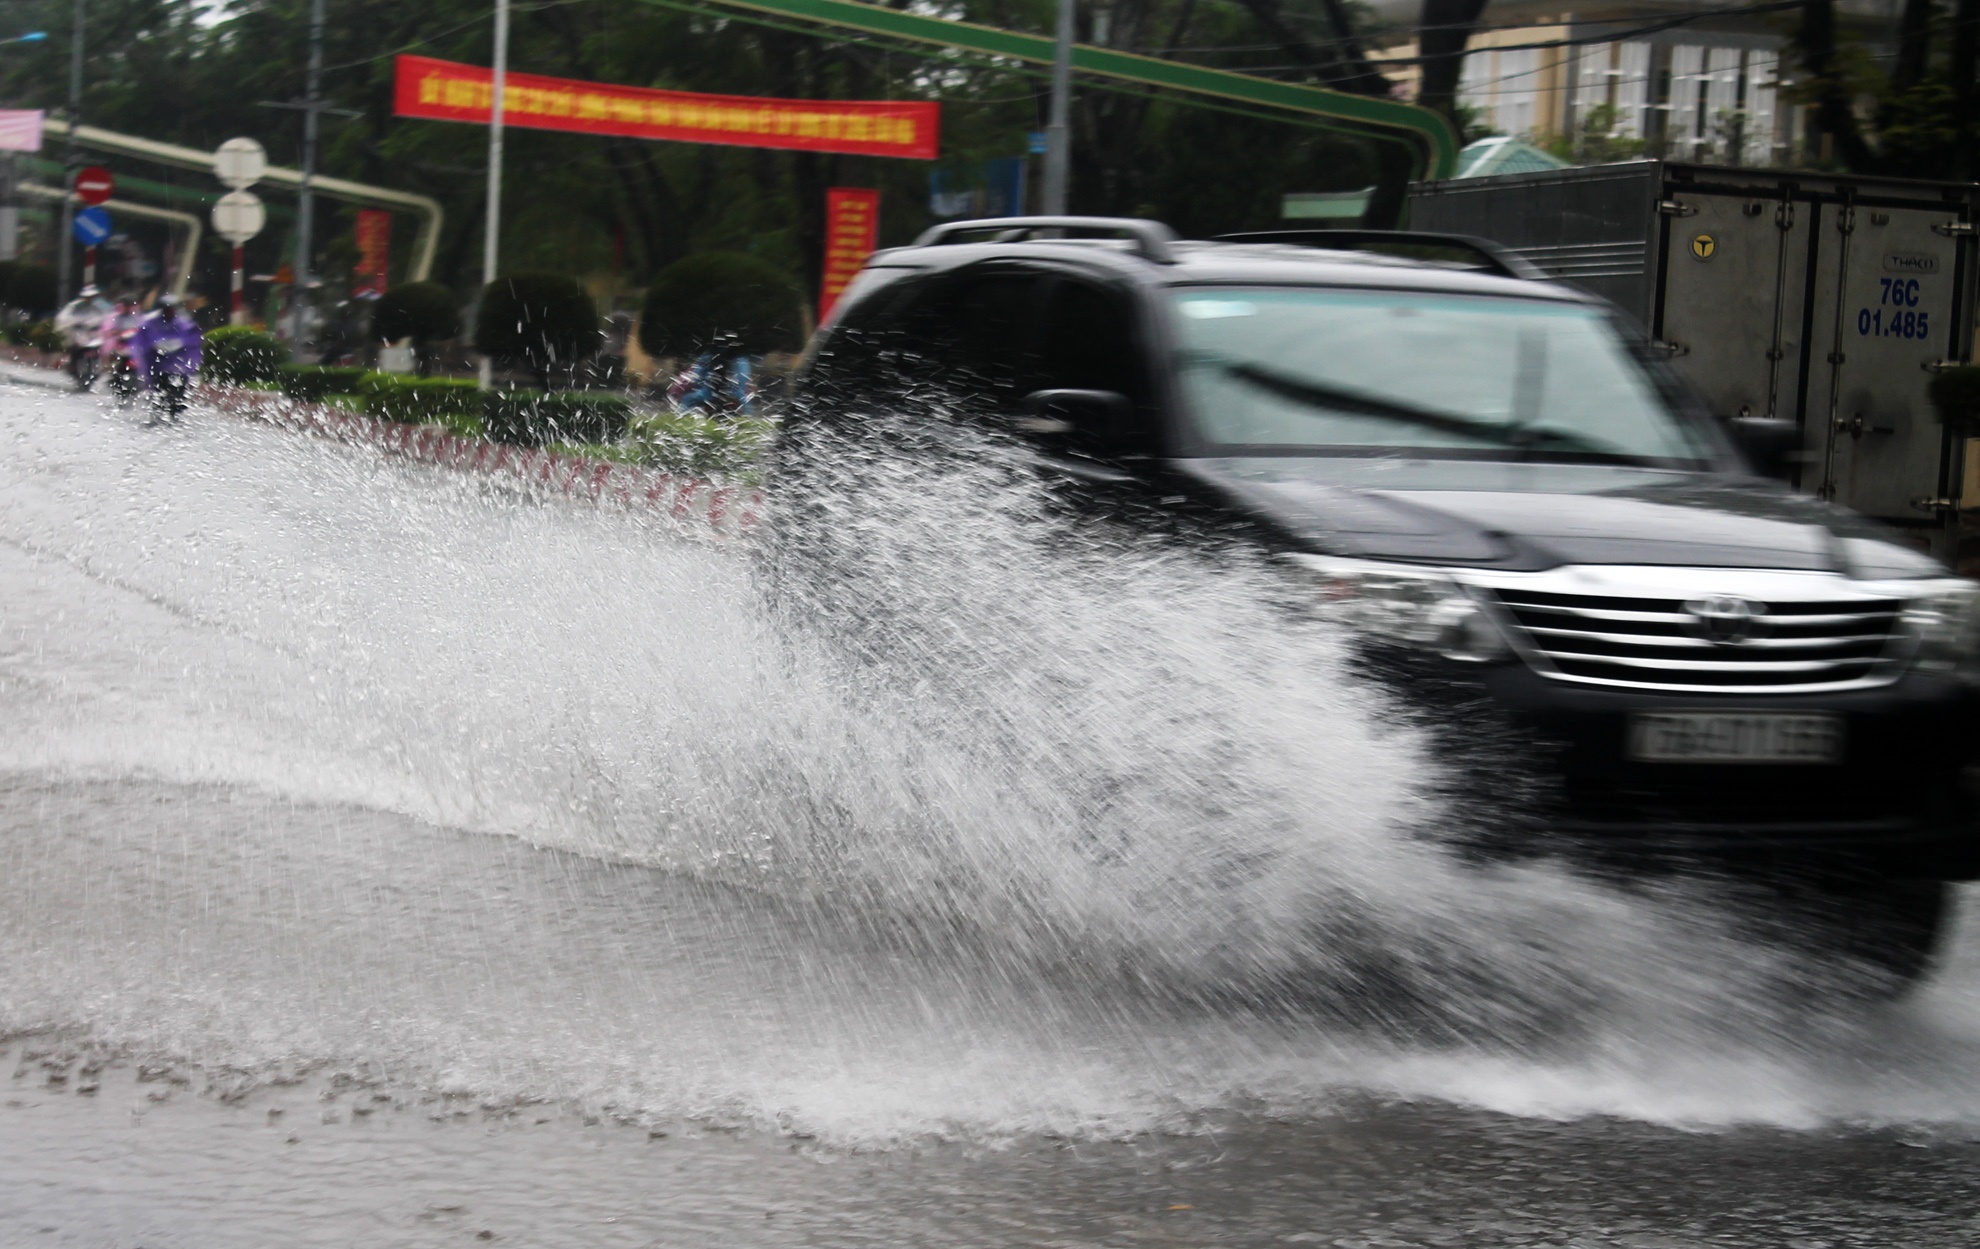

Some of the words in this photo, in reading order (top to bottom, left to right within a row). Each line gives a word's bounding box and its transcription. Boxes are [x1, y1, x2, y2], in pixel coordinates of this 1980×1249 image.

[1891, 256, 1933, 270] THACO
[1880, 278, 1920, 307] 76C
[1858, 308, 1928, 340] 01.485
